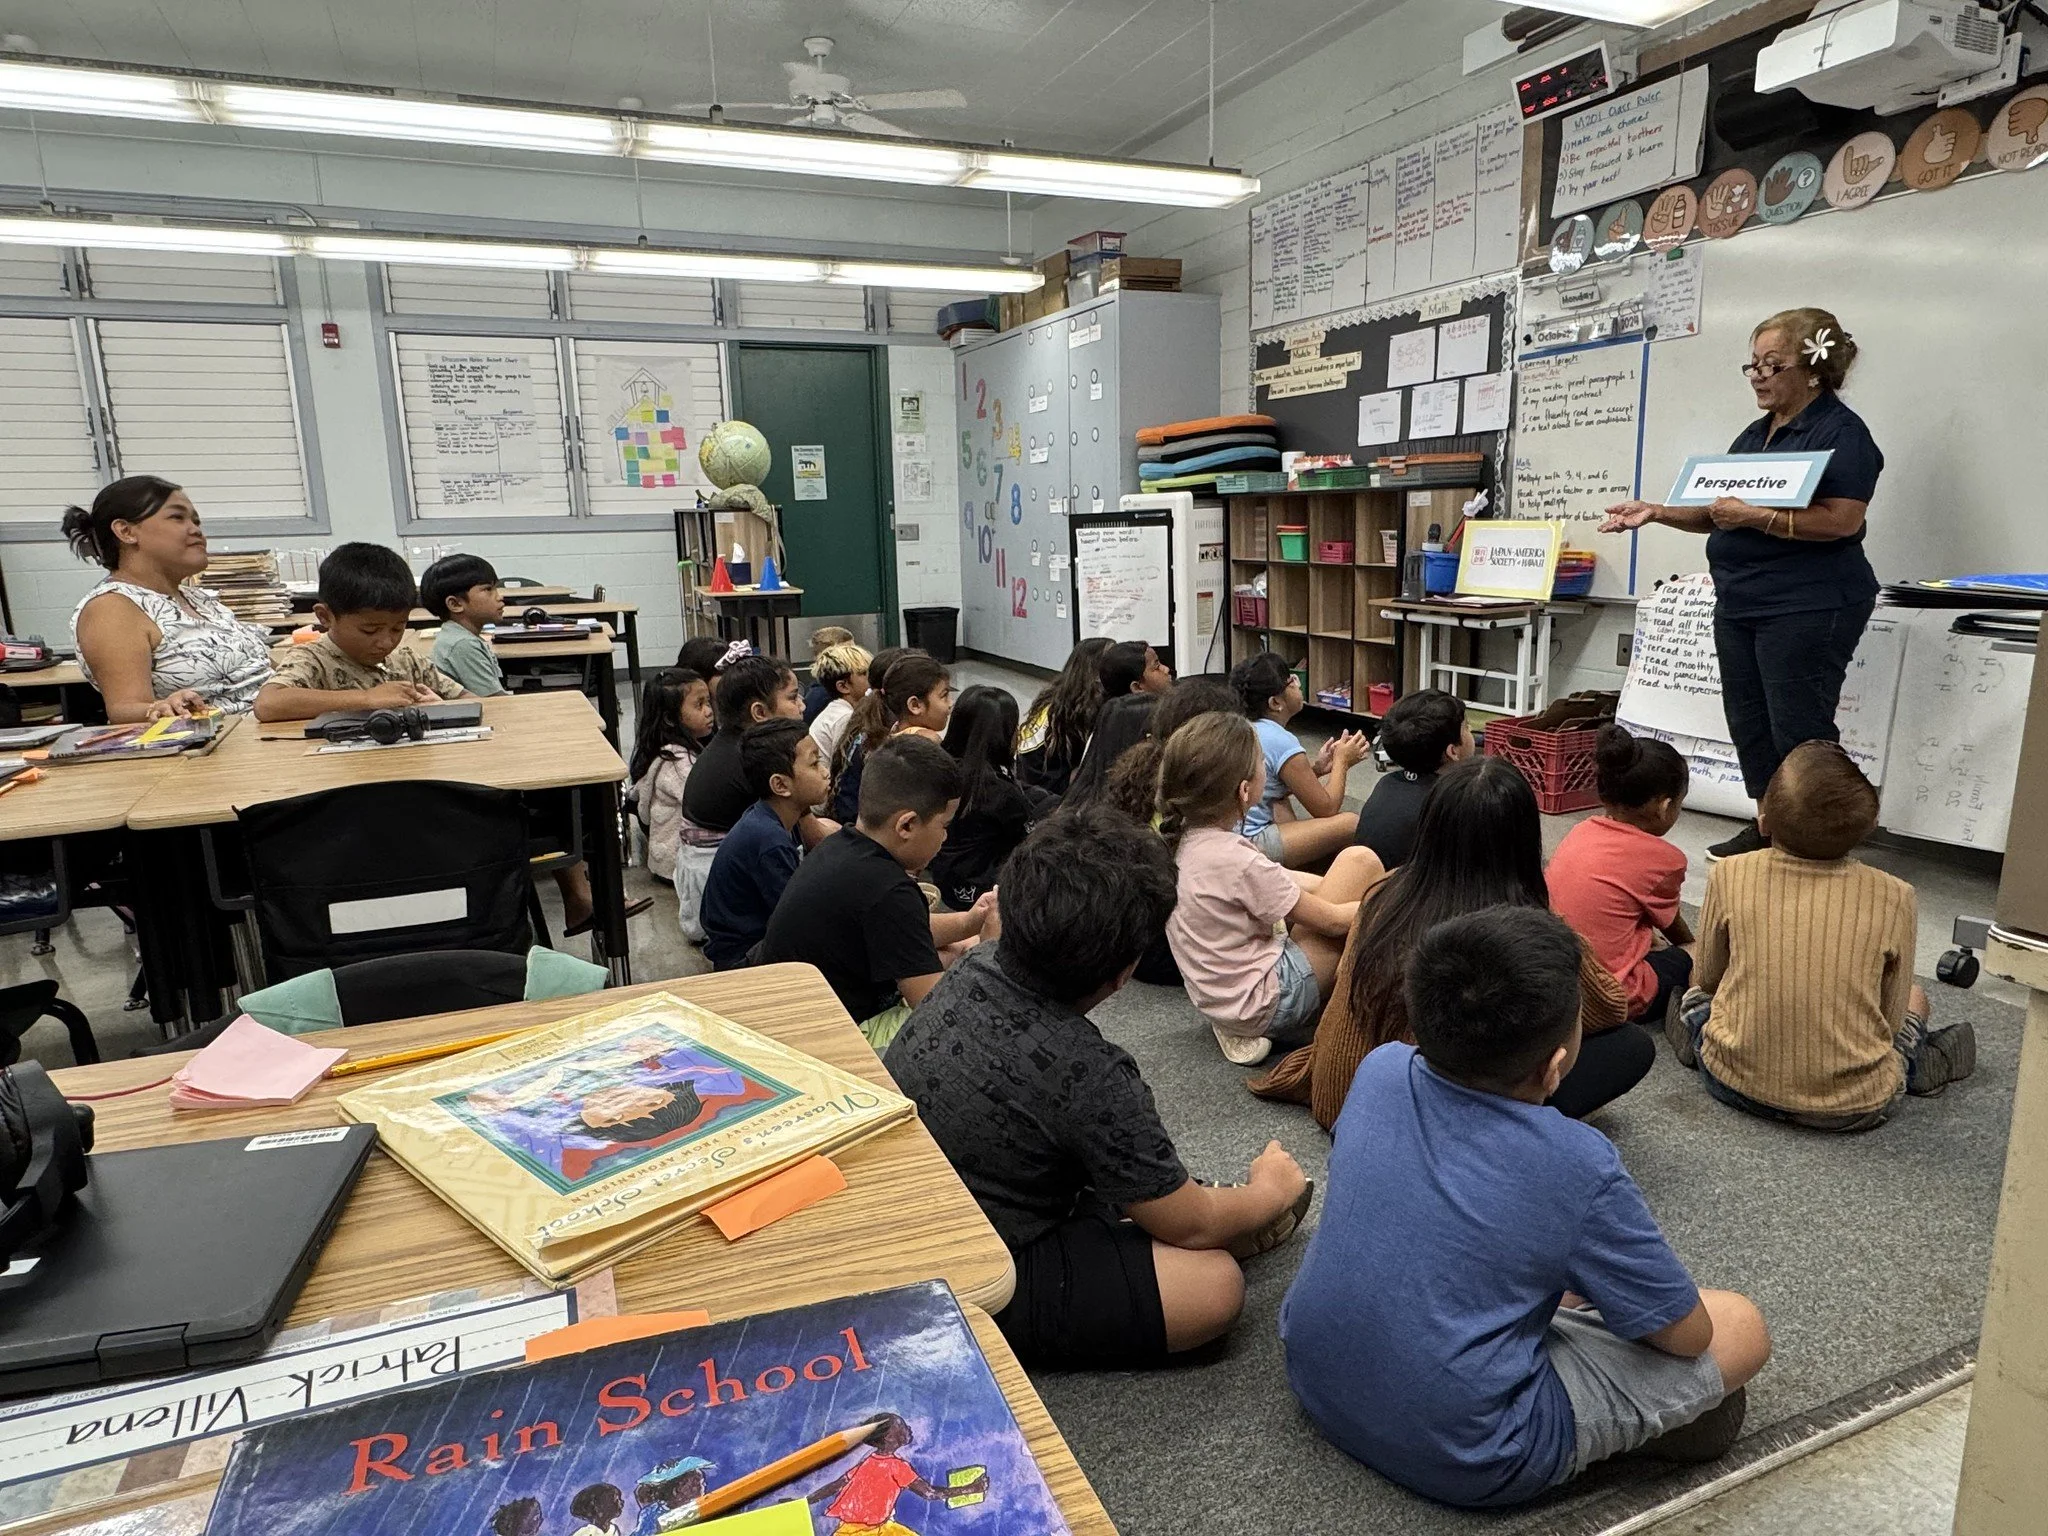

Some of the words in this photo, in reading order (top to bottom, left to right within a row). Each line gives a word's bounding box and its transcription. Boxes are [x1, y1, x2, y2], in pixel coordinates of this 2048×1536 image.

[1608, 102, 1631, 118] Class
[1636, 91, 1661, 107] Rules
[1570, 135, 1592, 150] Make
[1597, 124, 1612, 138] safe
[1618, 111, 1649, 130] choices
[1569, 153, 1581, 164] Be
[1586, 136, 1621, 158] respectful
[1998, 150, 2019, 165] NOT
[1569, 167, 1585, 179] Stay
[1590, 152, 1623, 172] focused
[1627, 148, 1634, 160] &
[1639, 142, 1664, 156] learn
[1917, 166, 1940, 186] GOT
[1942, 163, 1954, 179] IT
[1582, 179, 1599, 197] your
[1843, 184, 1871, 201] AGREE
[1764, 201, 1804, 219] QUESTION
[1708, 215, 1739, 233] TISSUE
[1562, 291, 1594, 305] Monday
[1428, 302, 1450, 316] Math
[1314, 363, 1329, 373] reading
[1520, 359, 1551, 371] Learning
[1554, 354, 1579, 369] Targets
[1544, 381, 1563, 391] write
[1588, 370, 1626, 389] paragraph
[961, 361, 968, 401] 1
[976, 378, 987, 420] 2
[992, 398, 1004, 441] 3
[1530, 399, 1539, 410] my
[1543, 392, 1568, 407] reading
[1571, 388, 1602, 401] contract
[1528, 414, 1541, 422] can
[1545, 408, 1570, 421] fluently
[1573, 406, 1589, 417] read
[1606, 403, 1634, 415] excerpt
[1538, 422, 1551, 432] text
[1551, 420, 1571, 430] aloud
[1574, 418, 1584, 428] for
[1584, 419, 1594, 427] an
[1596, 414, 1633, 426] audiobook
[961, 429, 973, 470] 5
[976, 447, 987, 487] 6
[993, 463, 1004, 505] 7
[1010, 482, 1022, 526] 8
[1518, 473, 1542, 487] Multiply
[1544, 471, 1561, 480] with
[1588, 471, 1600, 480] and
[1602, 469, 1609, 481] 6
[1693, 476, 1788, 492] Perspective
[1537, 486, 1555, 501] apart
[1563, 484, 1584, 495] factor
[1610, 484, 1632, 499] array
[1519, 499, 1525, 509] to
[1528, 499, 1541, 511] help
[1544, 496, 1568, 511] multiply
[1544, 511, 1554, 520] the
[1556, 511, 1573, 521] order
[1574, 511, 1581, 521] of
[1582, 511, 1603, 521] factors
[963, 500, 975, 540] 9
[977, 524, 992, 565] 10
[995, 548, 1006, 589] 11
[1011, 576, 1028, 619] 12
[1488, 546, 1546, 561] JAPAN-AMERICA
[1490, 557, 1517, 567] SOCIETY
[1662, 585, 1686, 596] read
[1688, 586, 1703, 596] at
[1660, 595, 1678, 604] and
[1684, 597, 1716, 607] volume
[1678, 618, 1693, 630] all
[1696, 620, 1711, 632] the
[1667, 636, 1699, 647] correct
[1682, 649, 1693, 658] so
[1696, 649, 1706, 658] it
[1674, 660, 1714, 676] smoothly
[1664, 682, 1682, 691] with
[725, 1117, 768, 1140] STORY
[742, 1091, 880, 1148] Nasreen's
[682, 1137, 721, 1158] FROM
[651, 1145, 738, 1188] Secret
[570, 1156, 676, 1205] AFGHANISTAN
[537, 1187, 643, 1238] School
[290, 1335, 463, 1408] Patrick
[65, 1384, 250, 1446] Villena
[341, 1407, 564, 1499] Rain
[597, 1325, 873, 1435] School
